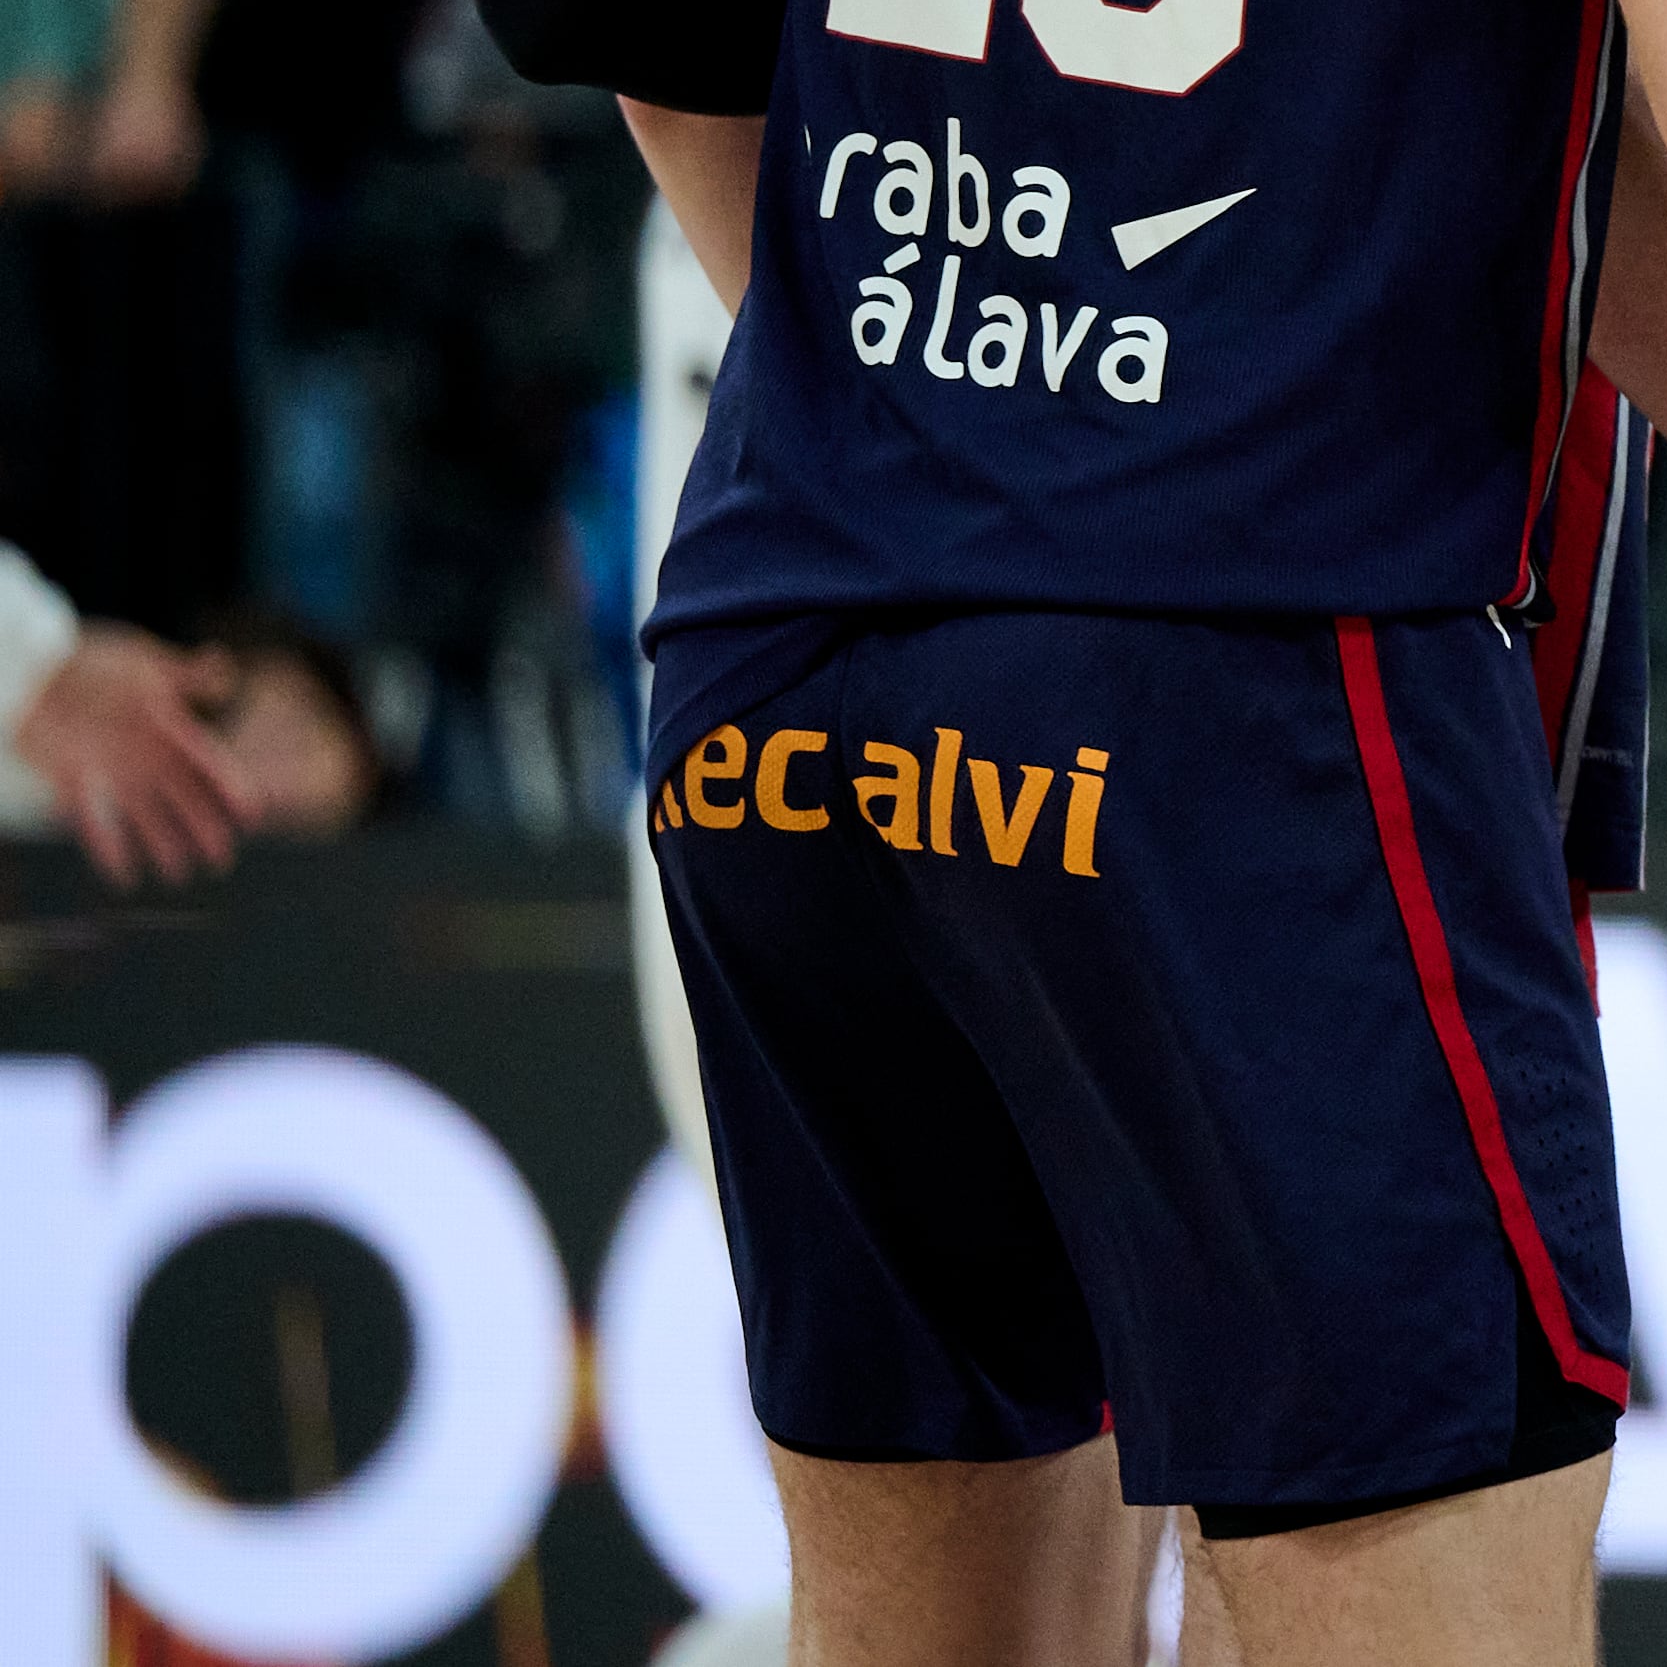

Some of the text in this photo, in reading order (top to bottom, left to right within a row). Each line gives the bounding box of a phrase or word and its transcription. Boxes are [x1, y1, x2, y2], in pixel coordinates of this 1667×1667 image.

[804, 117, 1071, 259] raba
[851, 242, 1170, 404] álava
[852, 726, 1110, 879] alvi
